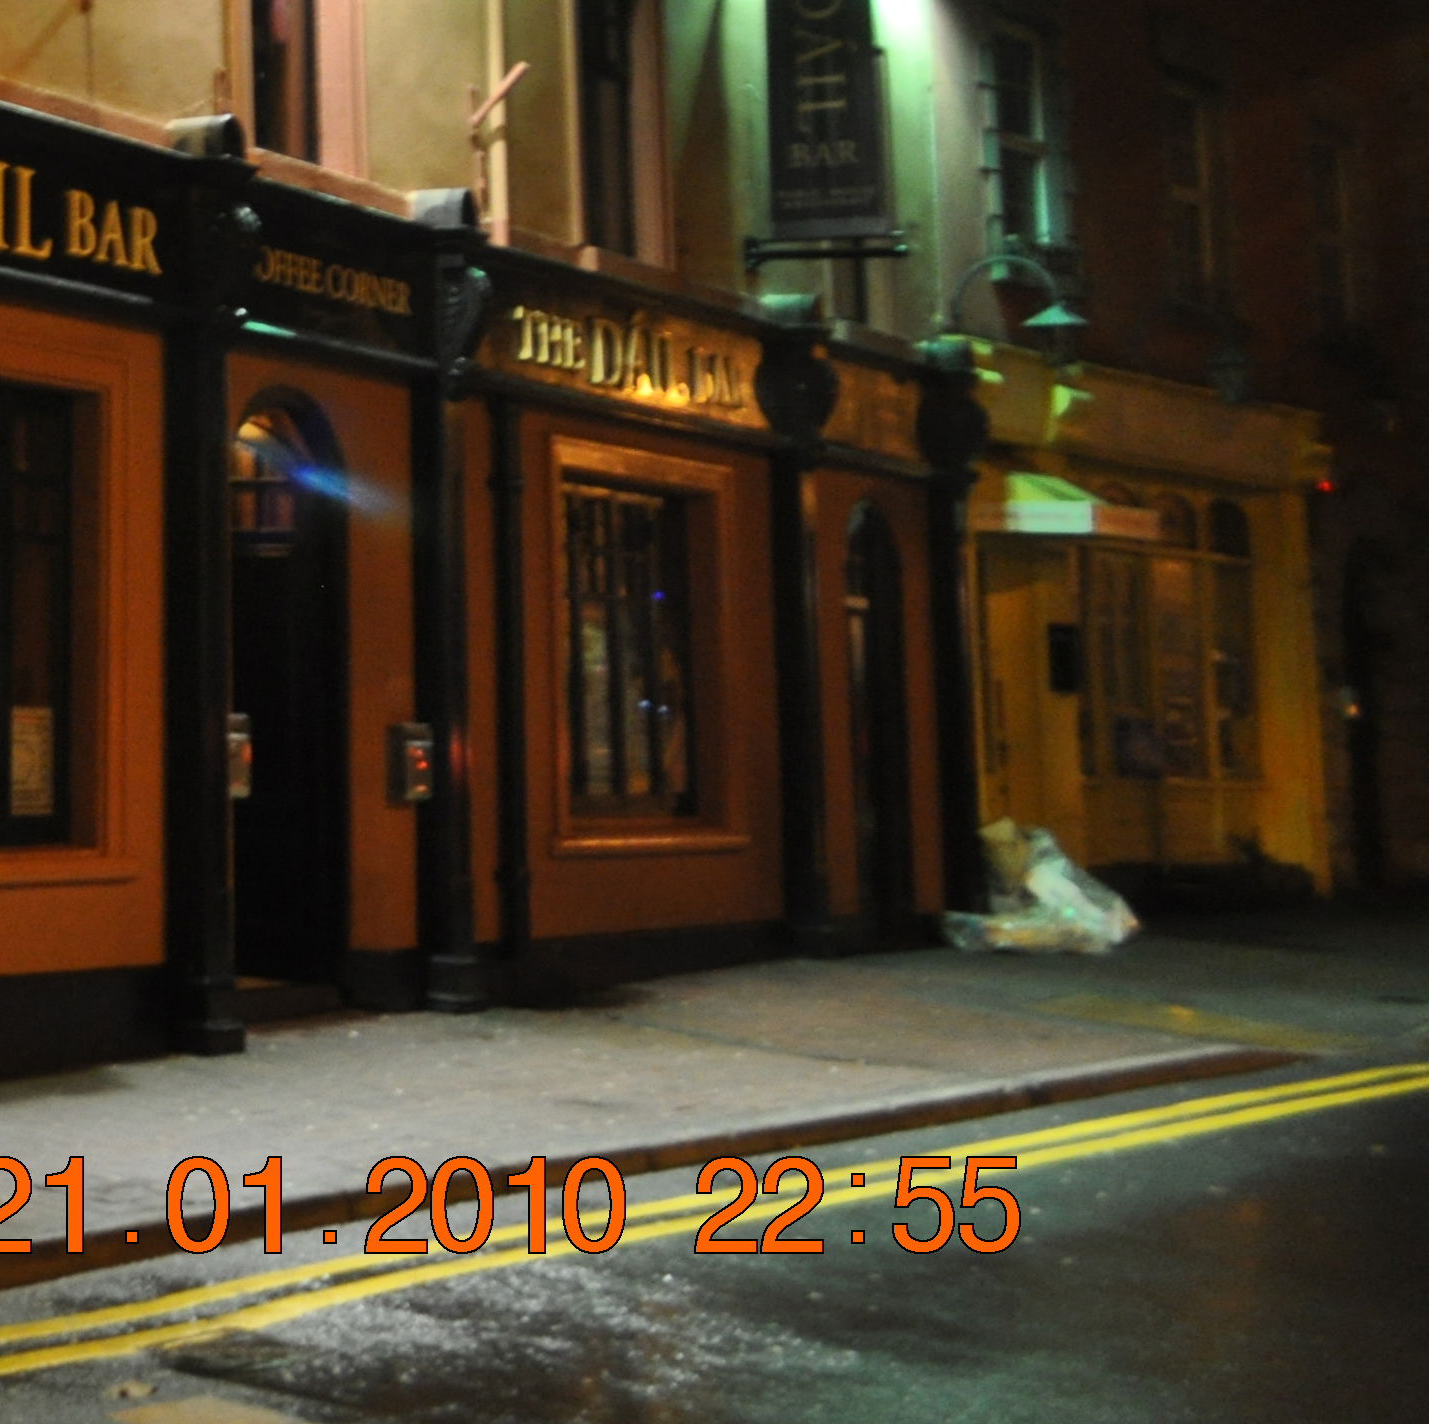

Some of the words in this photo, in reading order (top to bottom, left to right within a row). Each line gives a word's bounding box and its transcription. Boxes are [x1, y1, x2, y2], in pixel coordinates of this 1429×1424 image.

[789, 139, 859, 170] BAR
[64, 188, 163, 276] BAR
[253, 245, 323, 293] OFFEE
[326, 263, 412, 316] CORNER
[513, 305, 586, 369] THE
[589, 309, 690, 407] DÁIL
